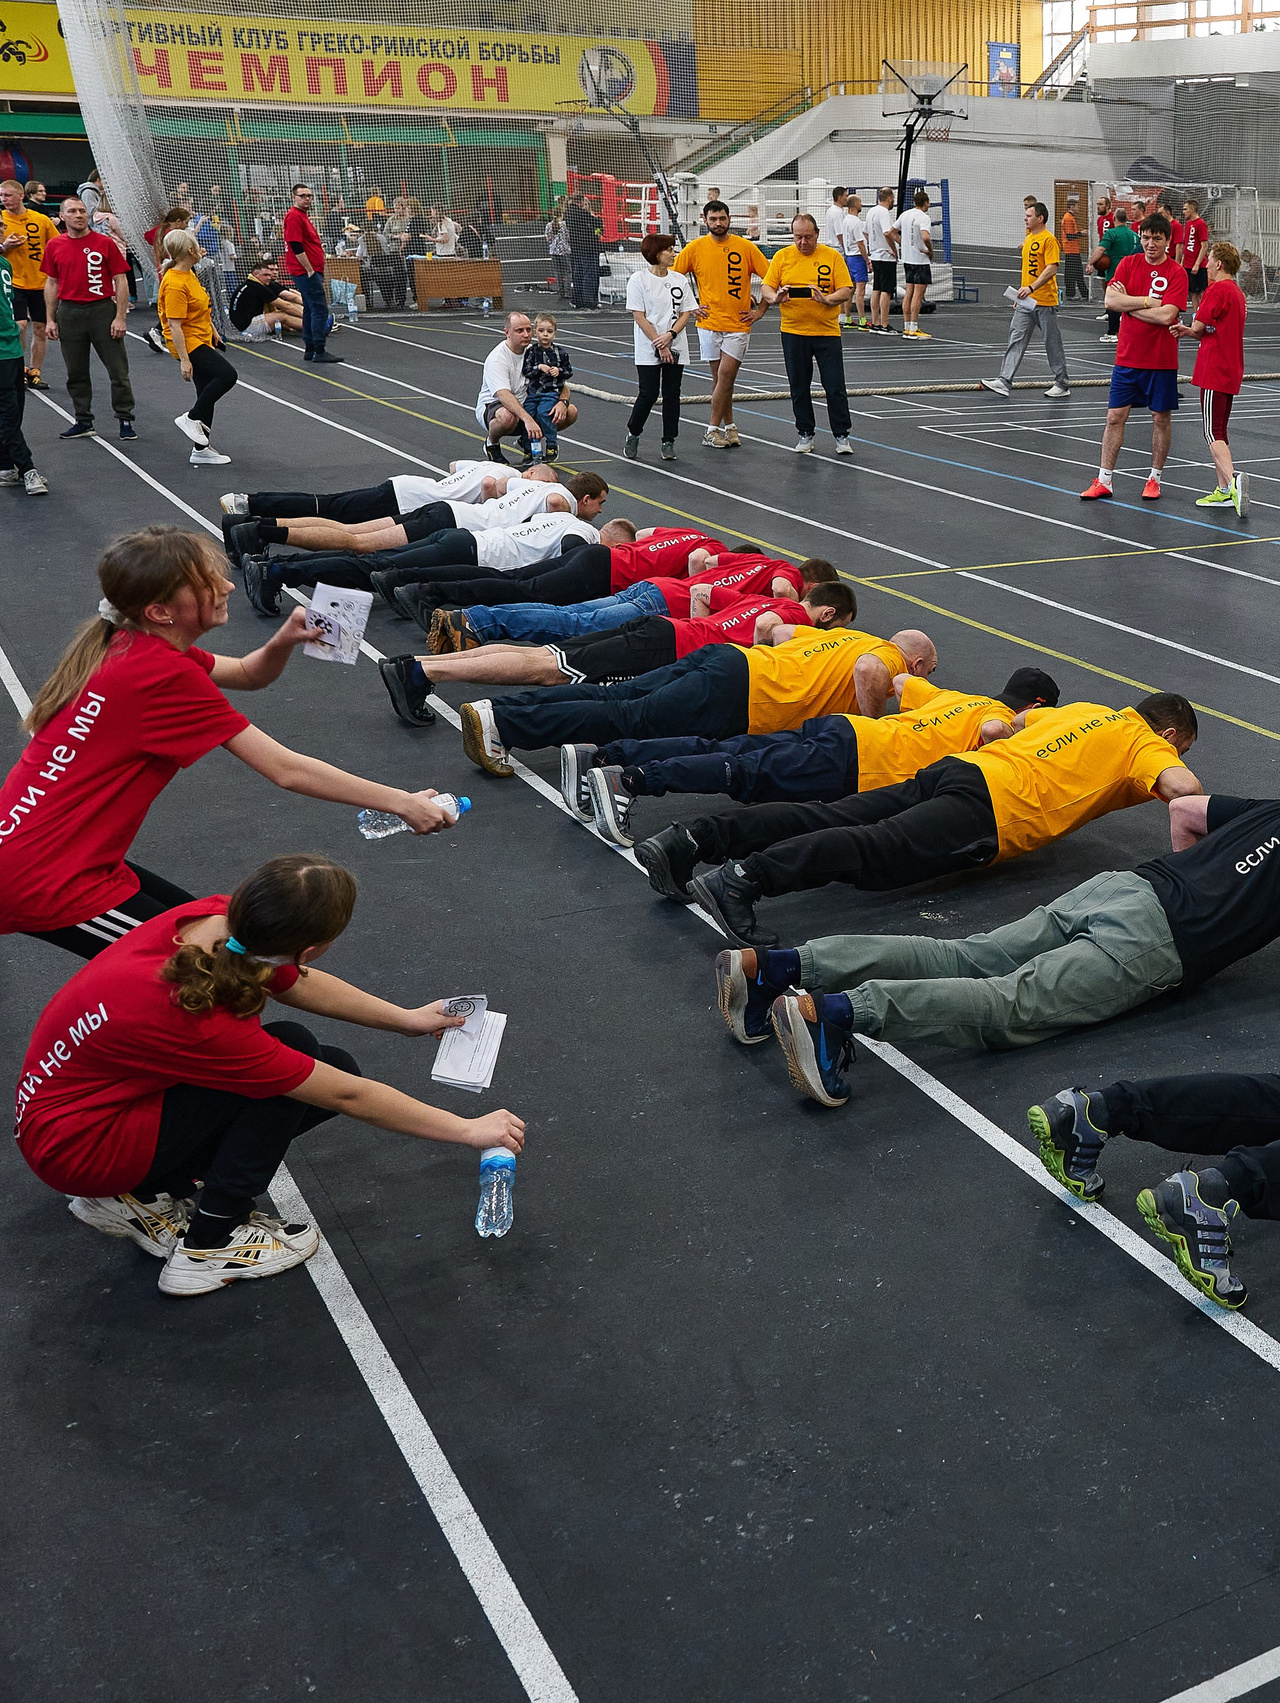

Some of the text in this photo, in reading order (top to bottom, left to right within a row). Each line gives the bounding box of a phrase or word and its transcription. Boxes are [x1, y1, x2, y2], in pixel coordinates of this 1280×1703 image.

[233, 26, 289, 51] КЛУБ
[297, 30, 470, 61] ГРЕКО-РИМСКОЙ
[479, 41, 561, 65] БОРЬБЫ
[132, 47, 510, 103] ЧЕМПИОН
[26, 222, 42, 262] АКТО
[1028, 241, 1040, 278] АКТО
[87, 251, 104, 296] АКТО
[728, 251, 742, 300] АКТО
[818, 264, 831, 294] КТО
[498, 496, 521, 510] ели
[648, 538, 680, 552] если
[713, 573, 746, 588] если
[803, 641, 840, 658] если
[912, 715, 942, 733] еси
[943, 705, 965, 720] не
[1036, 731, 1079, 759] если
[1079, 717, 1103, 734] не
[0, 691, 106, 844] сли не мы
[1234, 835, 1280, 875] если
[39, 1039, 72, 1077] не
[68, 1002, 109, 1047] мы
